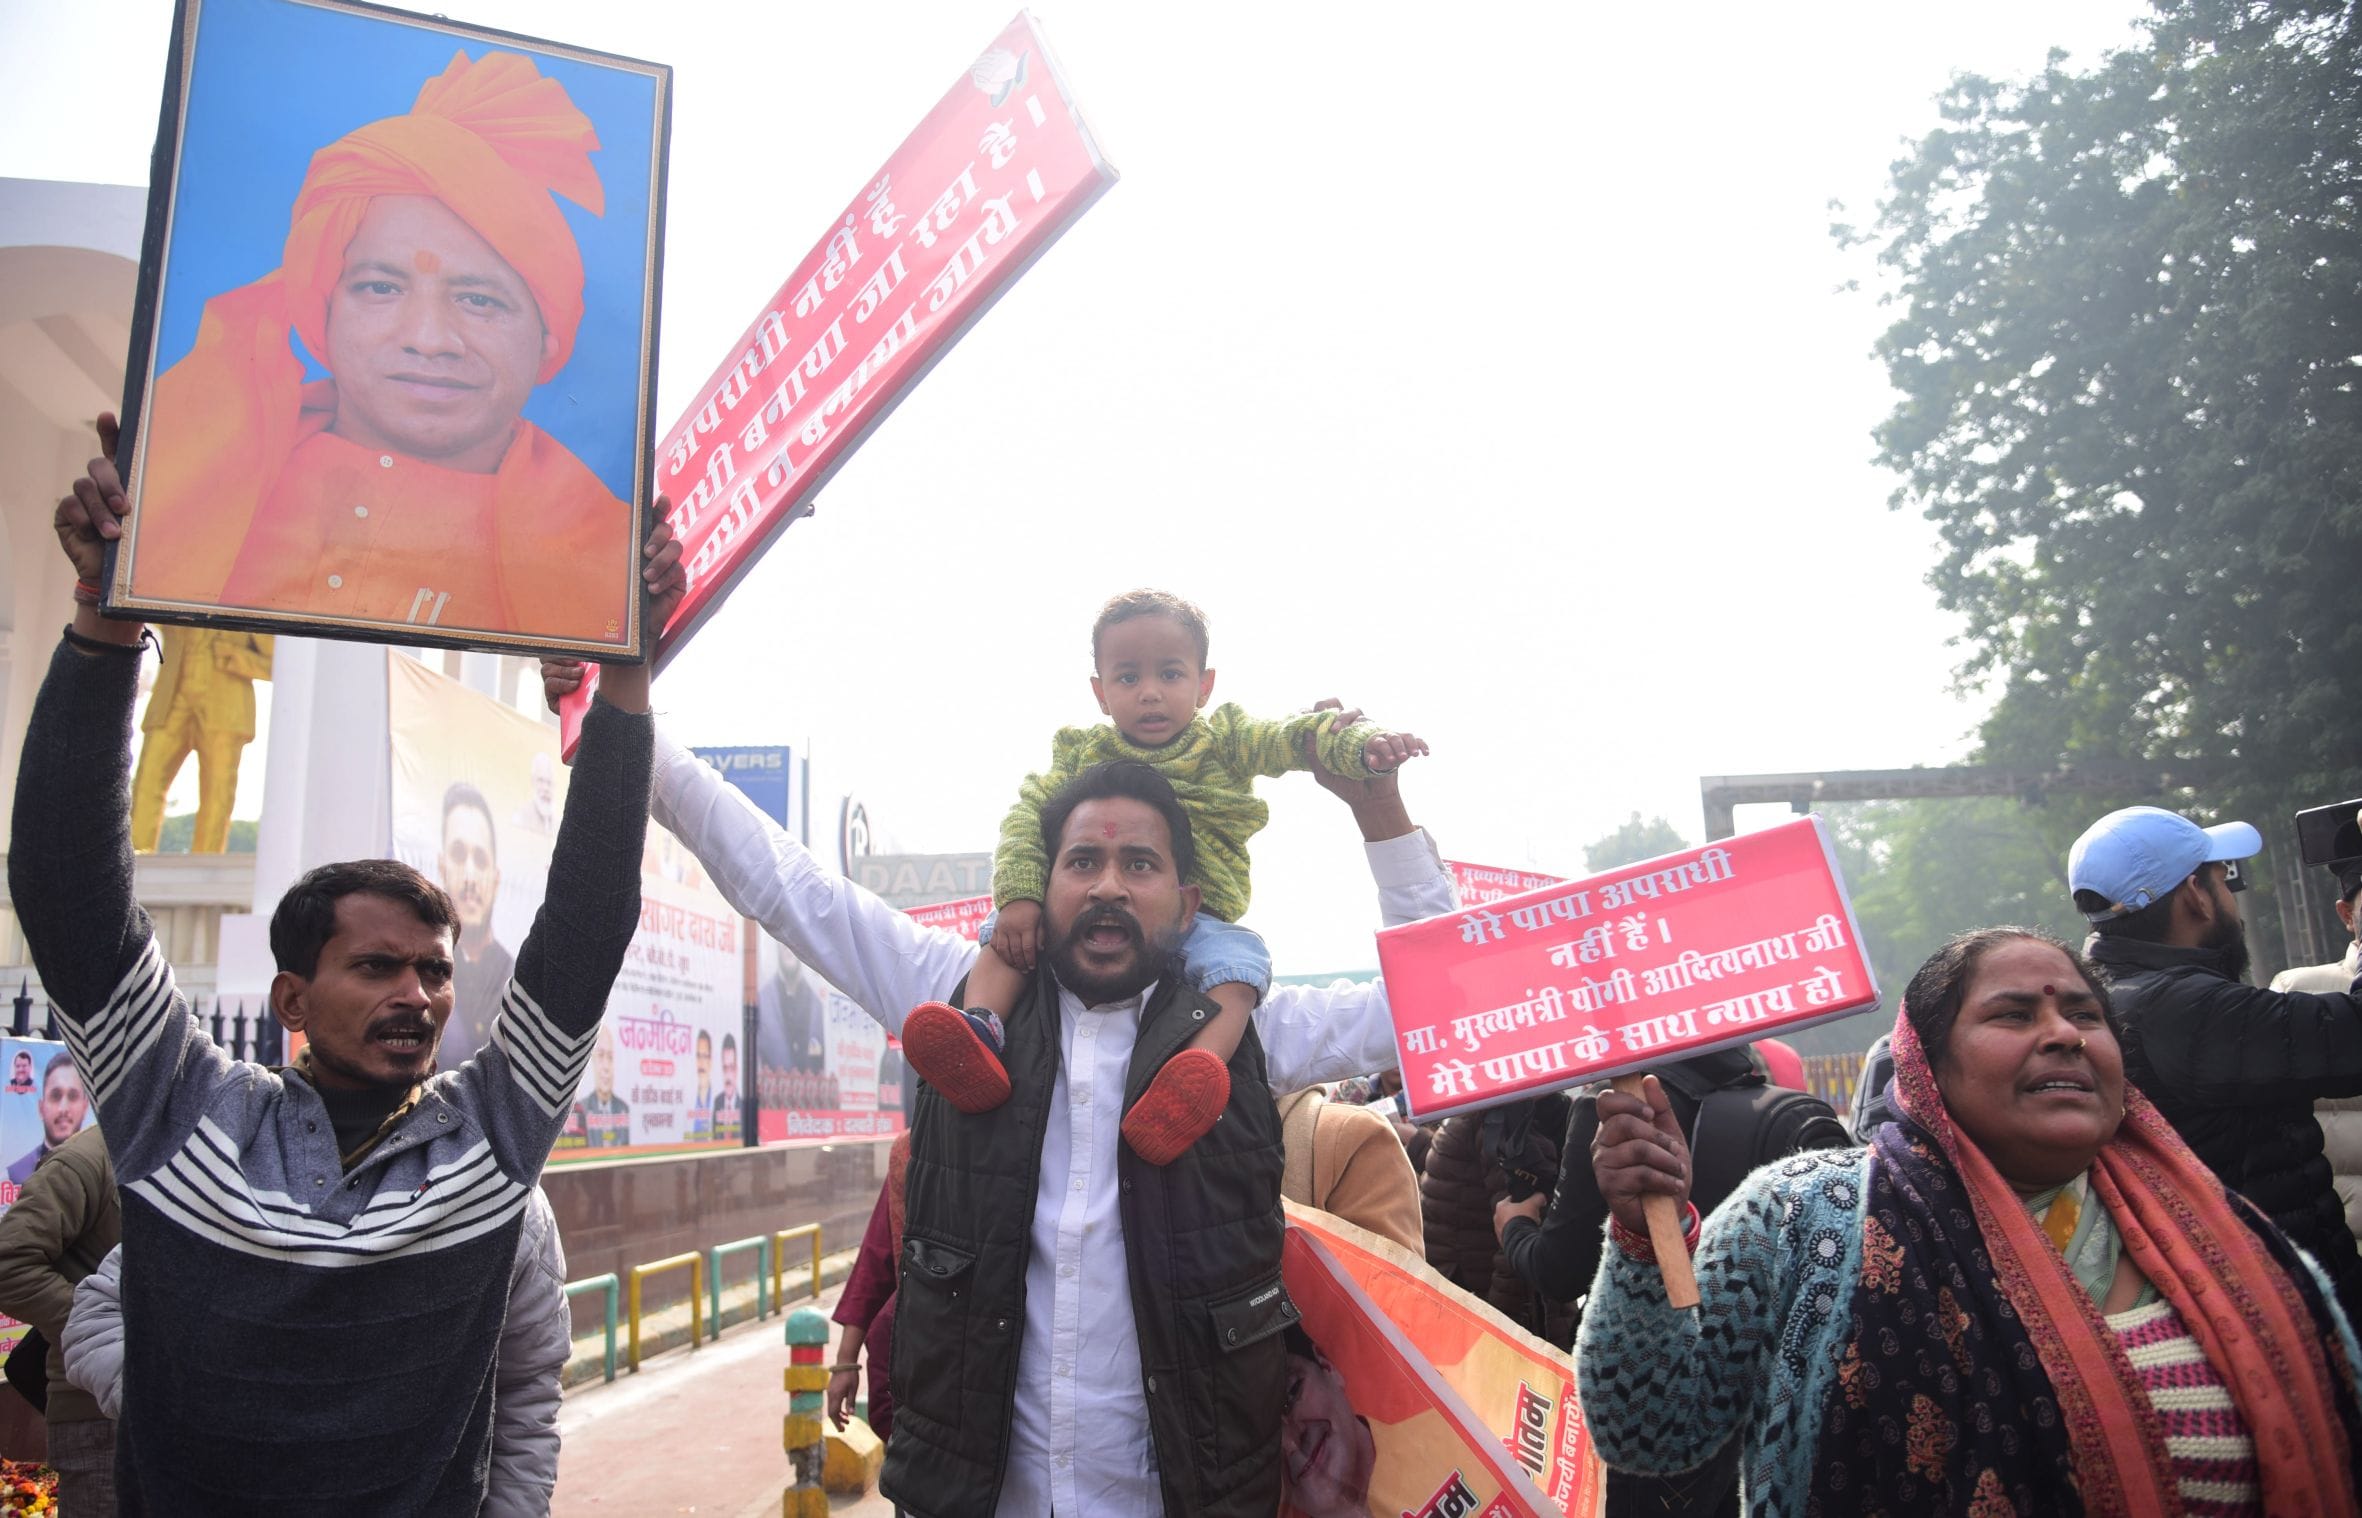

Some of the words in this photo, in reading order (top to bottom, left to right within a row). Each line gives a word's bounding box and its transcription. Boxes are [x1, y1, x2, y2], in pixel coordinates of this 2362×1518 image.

[665, 442, 737, 541] राधी
[738, 312, 849, 452] बनाया
[847, 242, 910, 323] जा
[909, 160, 981, 249] रहा
[668, 309, 792, 476] अपराधी
[790, 213, 863, 319] नहीं
[864, 173, 907, 240] हूँ
[685, 475, 764, 594] राधी
[860, 861, 992, 894] DAAT
[1457, 911, 1507, 945] मेरे
[1507, 890, 1594, 931] पापा
[1599, 848, 1736, 910] अपराधी
[1403, 1025, 1448, 1055] मा.
[1450, 986, 1568, 1053] मुख्यमंत्री
[1567, 967, 1639, 1013] योगी
[1641, 932, 1801, 996] आदित्यनाथ
[1797, 913, 1848, 953] जी
[1546, 920, 1618, 969] नहीं
[1428, 1059, 1478, 1097] मेरे
[1479, 1041, 1569, 1083] पापा
[1567, 1024, 1610, 1062] के
[1615, 1008, 1701, 1051] साथ
[1701, 984, 1799, 1026] न्याय
[1798, 965, 1848, 1006] हो
